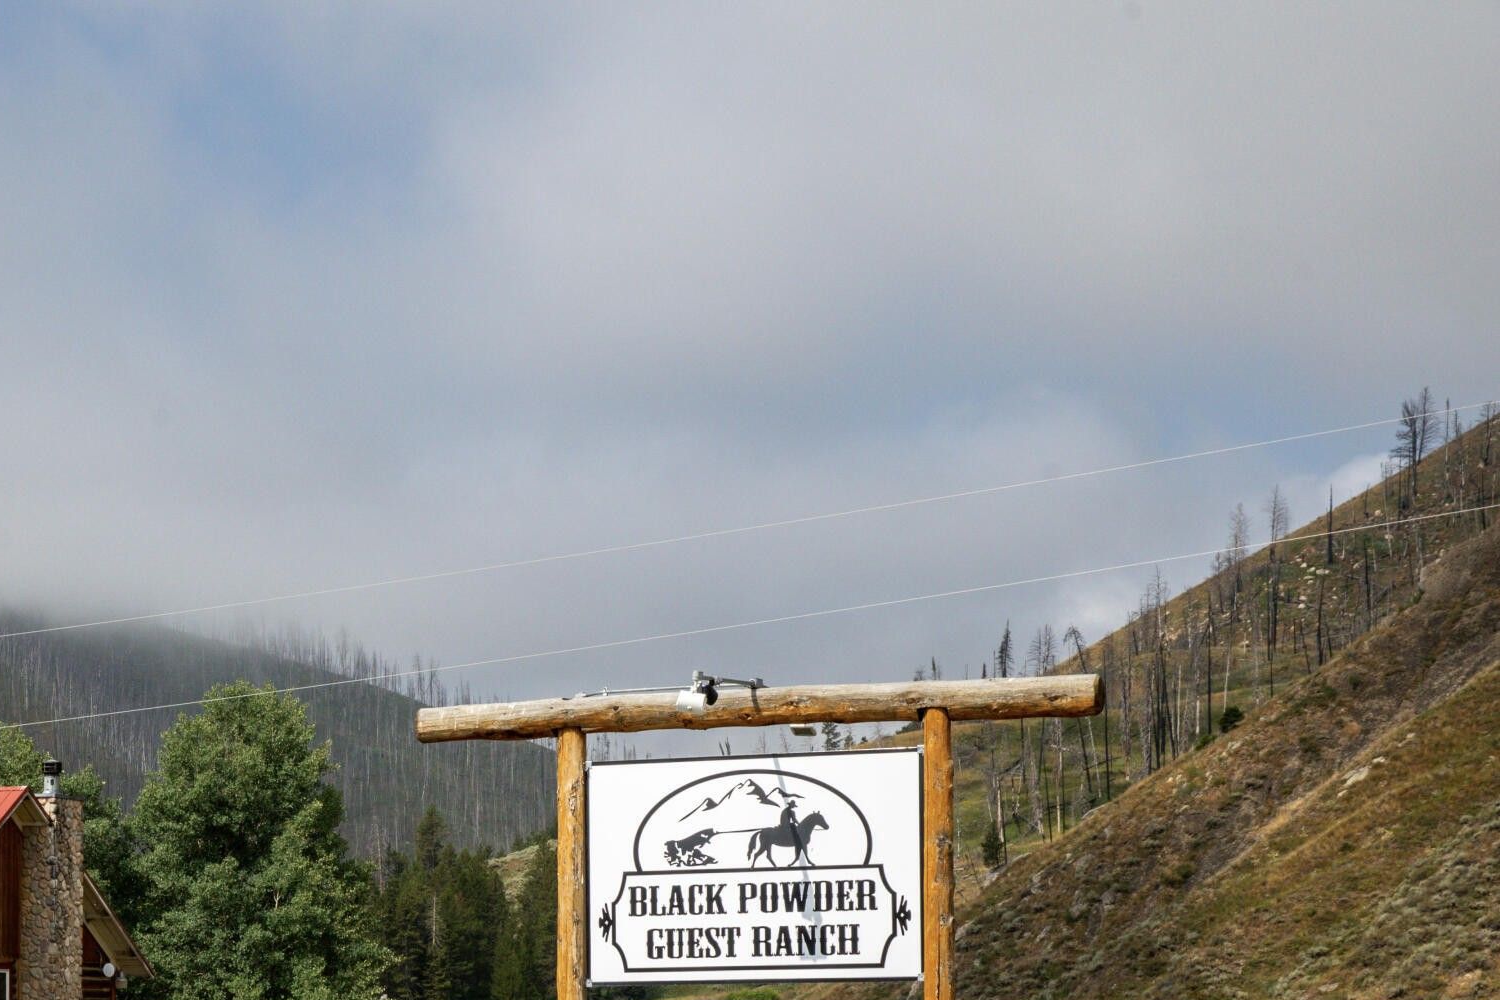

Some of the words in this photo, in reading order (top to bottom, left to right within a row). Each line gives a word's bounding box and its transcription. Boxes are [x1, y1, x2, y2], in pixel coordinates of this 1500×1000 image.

[628, 883, 728, 917] BLACK
[737, 879, 878, 915] POWDER
[646, 926, 741, 960] GUEST
[751, 924, 860, 958] RANCH
